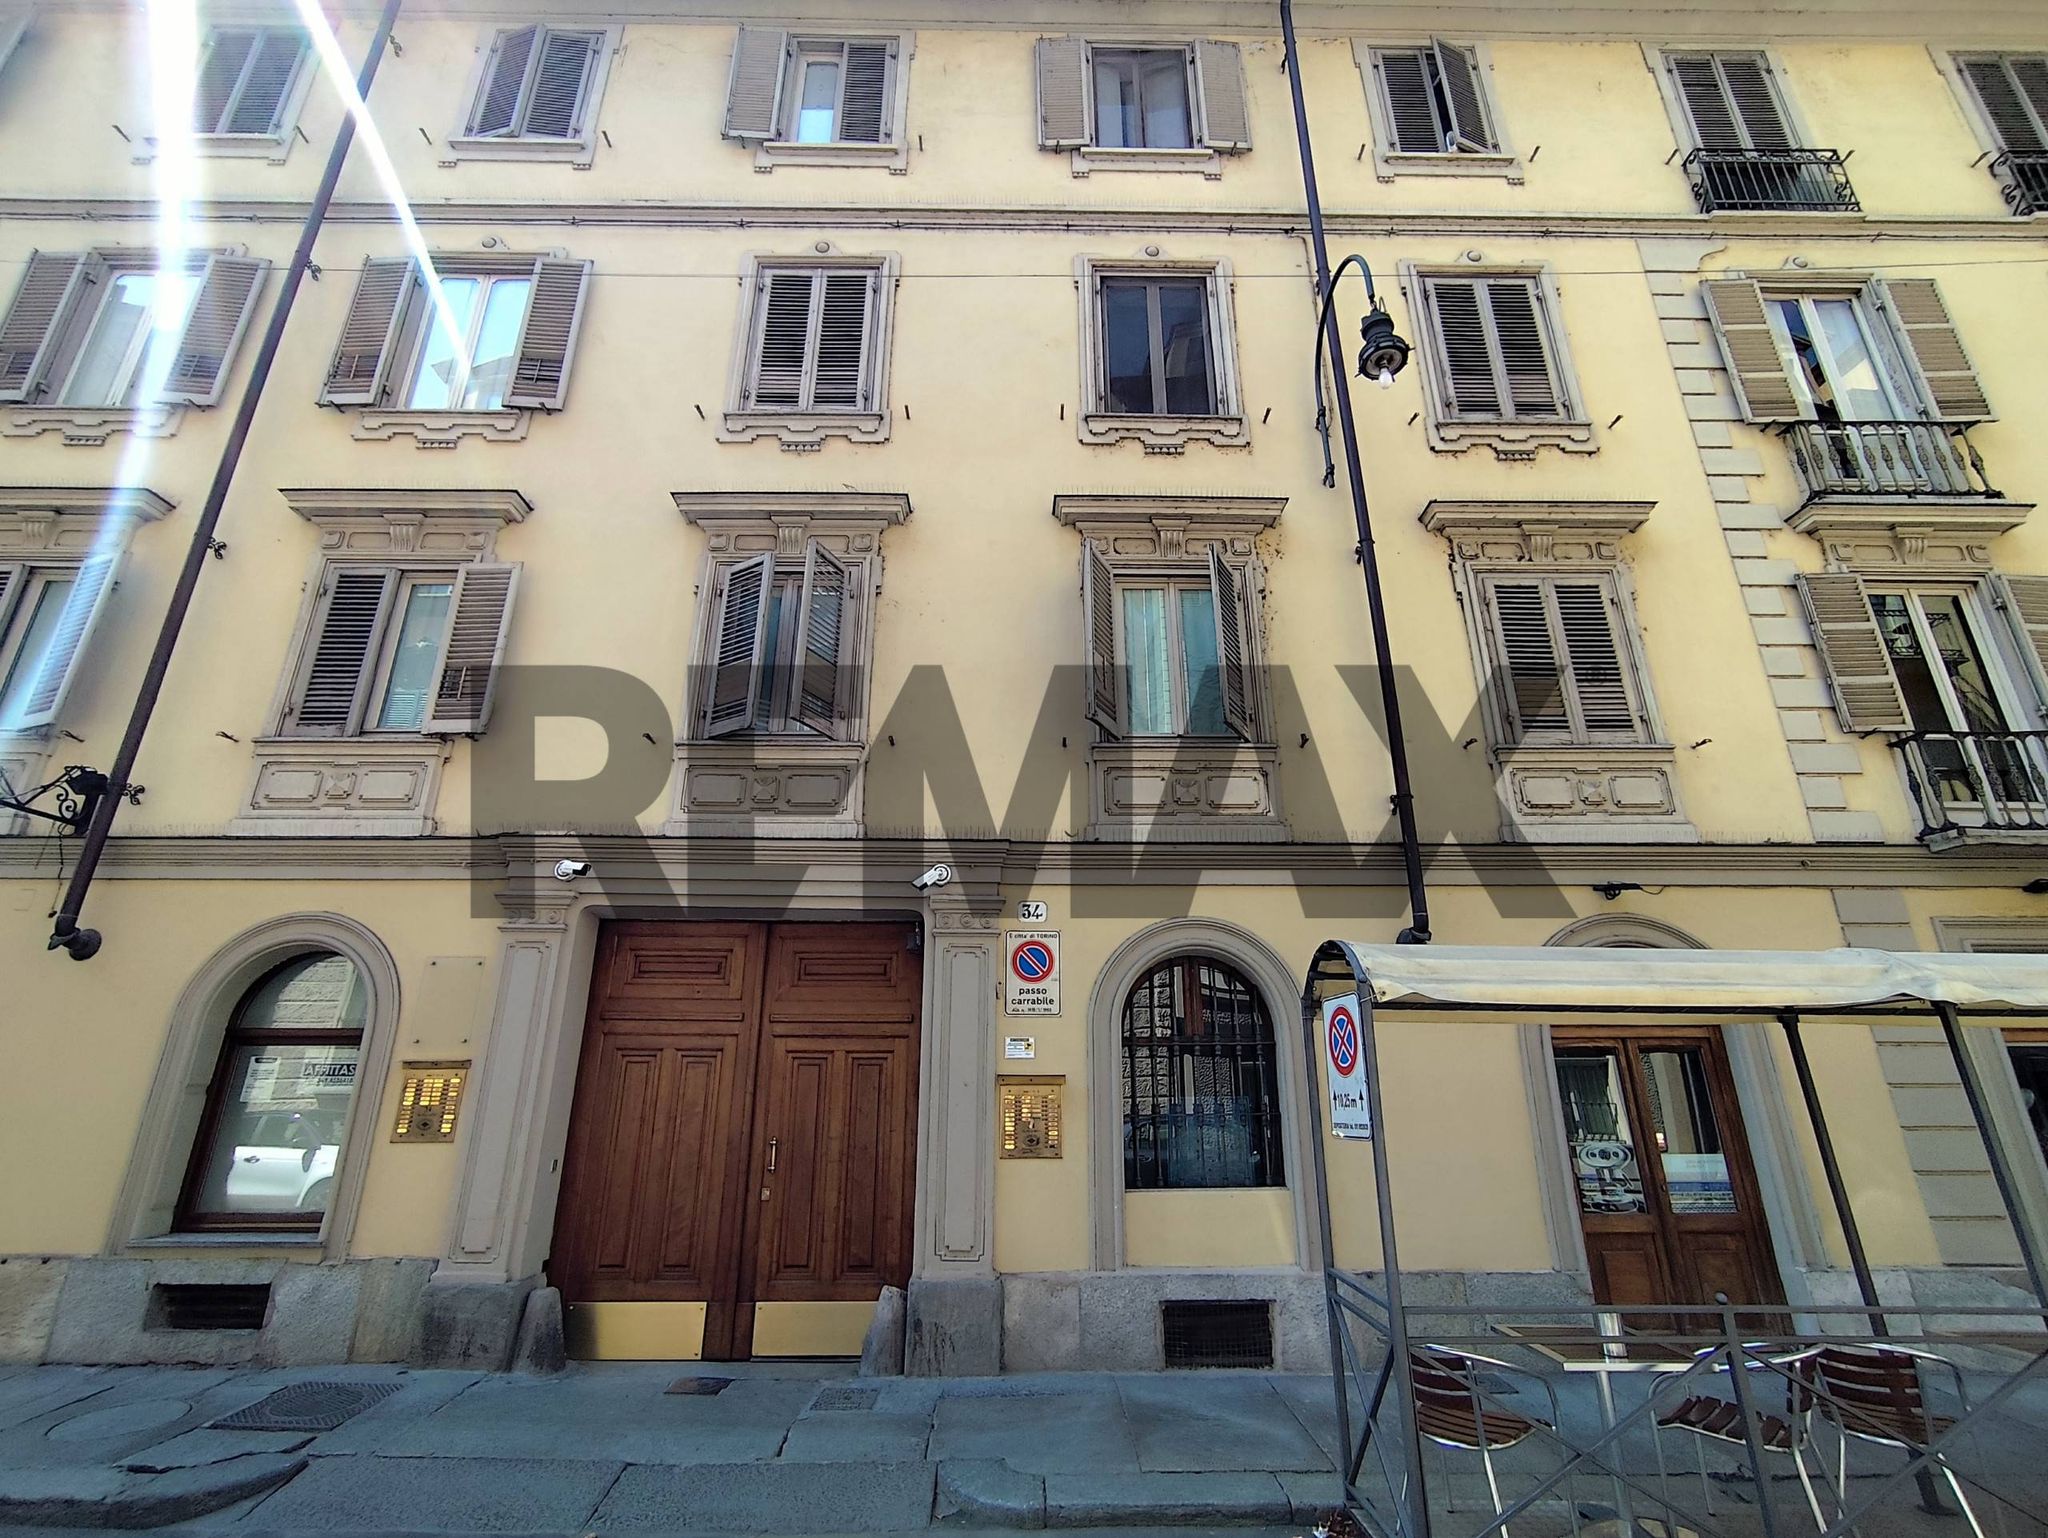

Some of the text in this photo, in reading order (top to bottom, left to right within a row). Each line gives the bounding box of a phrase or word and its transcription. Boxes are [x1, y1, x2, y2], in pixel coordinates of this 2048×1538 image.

[1021, 903, 1043, 920] 34
[1018, 987, 1048, 996] passo
[1011, 996, 1055, 1005] carrabile
